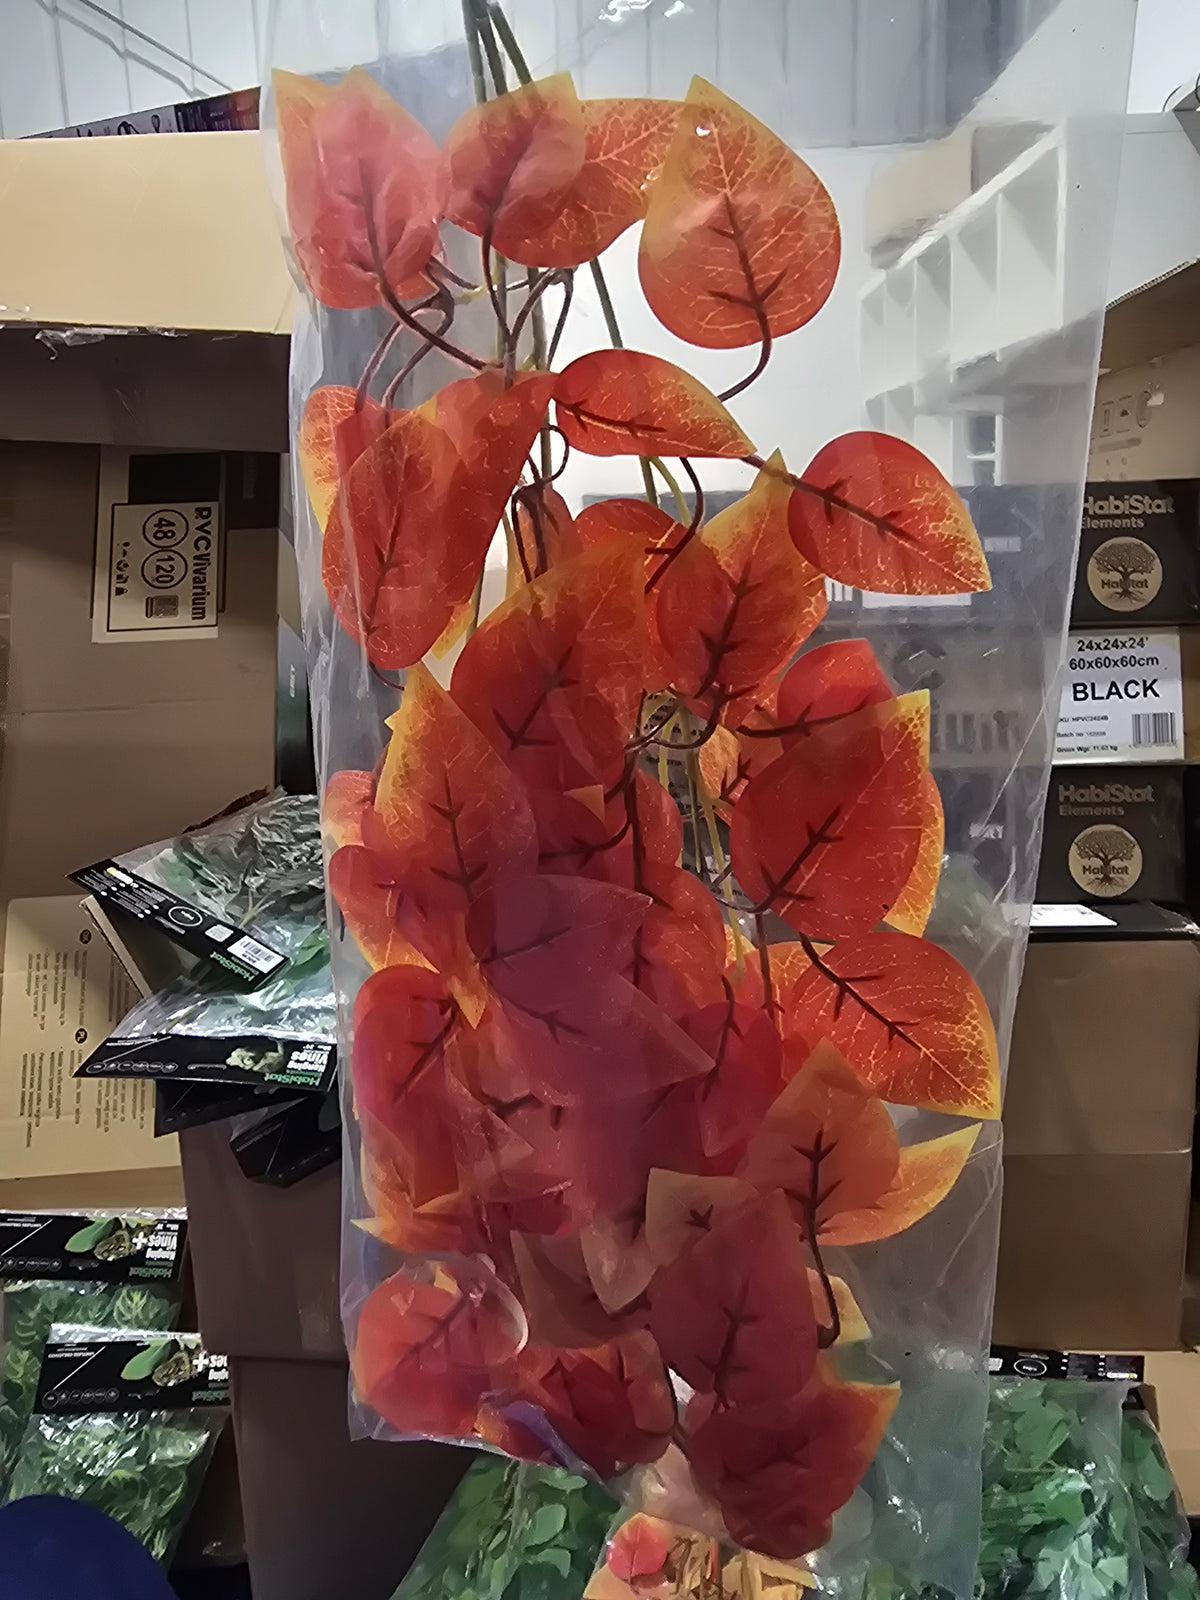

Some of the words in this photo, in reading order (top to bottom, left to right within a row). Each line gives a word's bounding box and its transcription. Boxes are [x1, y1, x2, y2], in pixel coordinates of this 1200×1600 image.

[153, 517, 176, 541] 48
[193, 506, 212, 551] PVC
[155, 555, 175, 584] 120
[191, 553, 211, 621] Vivarium
[1101, 578, 1149, 589] Hatat
[1069, 655, 1160, 671] 60x60x60cm
[1072, 678, 1160, 702] BLACK
[1058, 783, 1155, 803] HabiStat
[1059, 805, 1125, 816] Elements
[1082, 864, 1129, 876] Hatat
[209, 951, 256, 982] HabiStat
[290, 1051, 328, 1065] Vines
[286, 1061, 326, 1073] Hanging
[264, 1073, 321, 1087] HabiStat
[145, 1247, 176, 1260] Hanging
[128, 1266, 173, 1278] HabiStat
